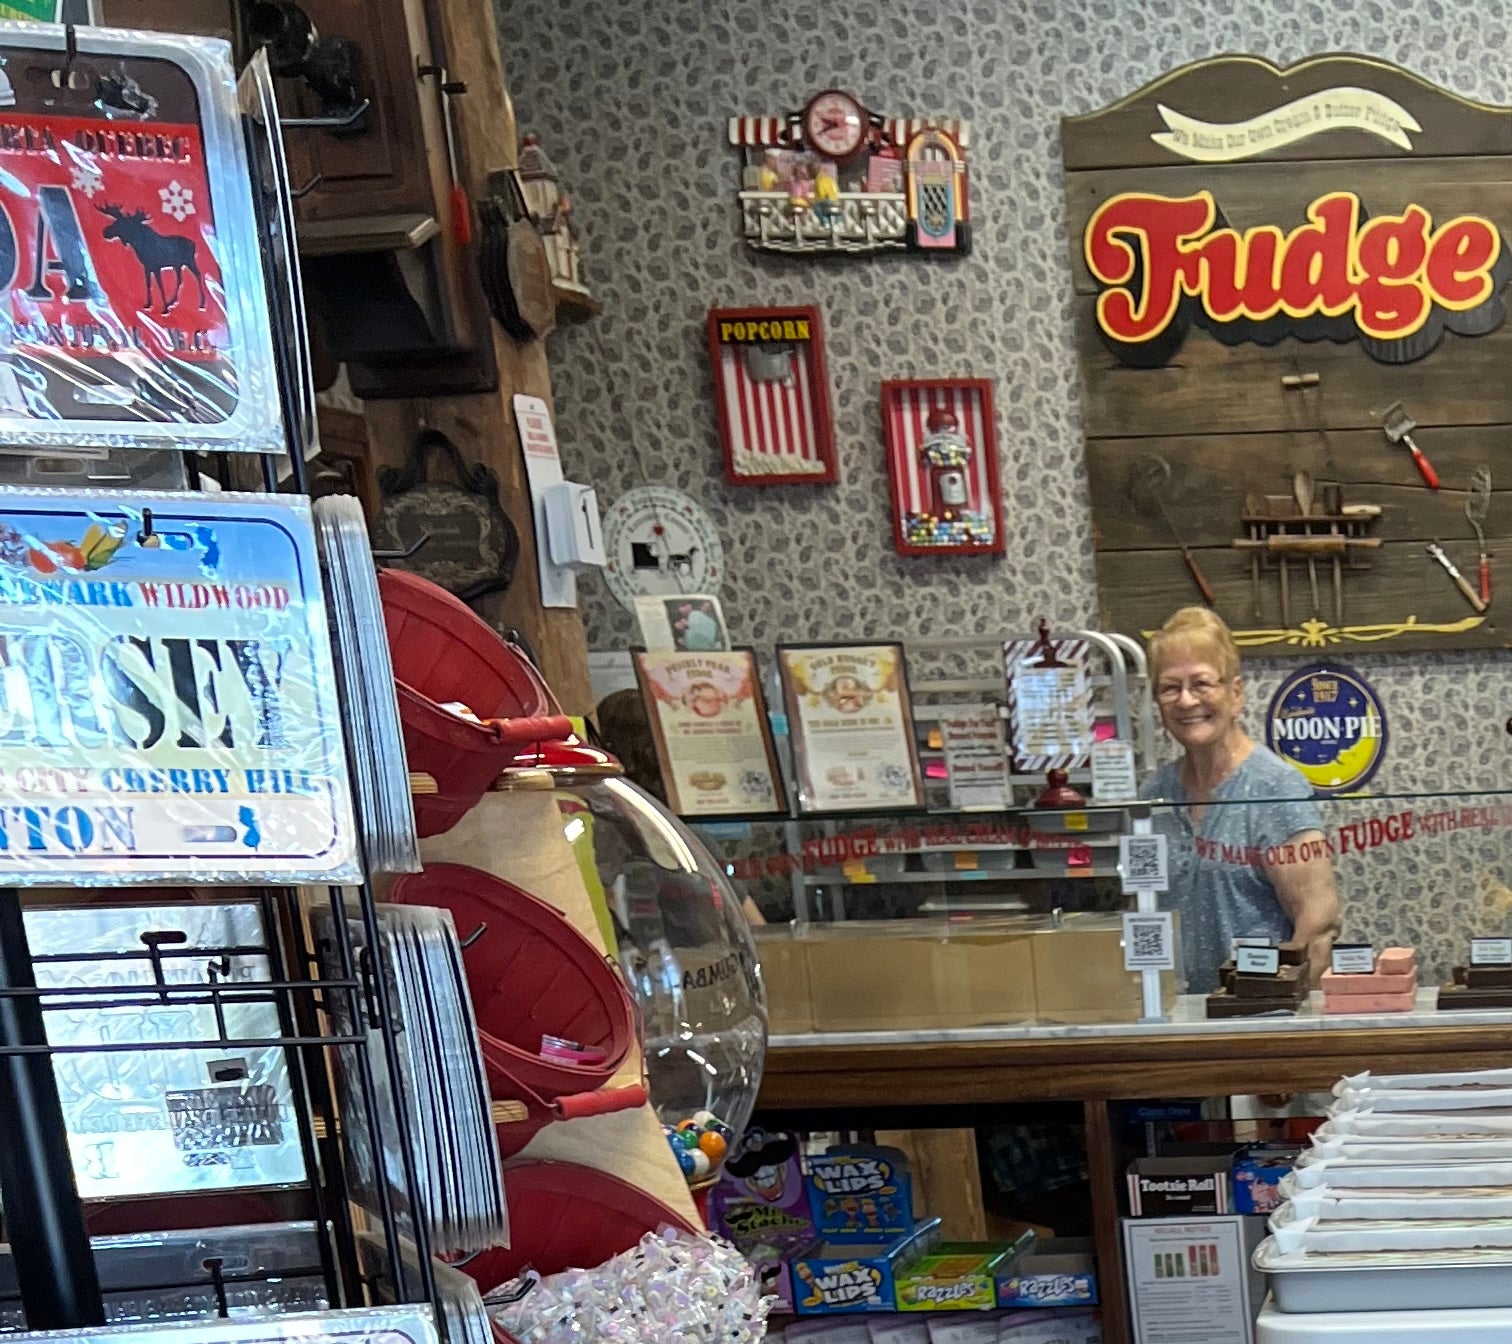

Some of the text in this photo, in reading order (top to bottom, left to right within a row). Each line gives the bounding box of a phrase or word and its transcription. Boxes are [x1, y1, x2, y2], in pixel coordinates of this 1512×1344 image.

[1086, 192, 1499, 343] Fudge
[720, 320, 810, 341] POPCORN
[139, 582, 291, 610] WILDWOOD
[0, 633, 294, 751] RSEY
[1272, 715, 1382, 740] MOON PIE
[102, 767, 230, 795] CHERRY
[1266, 843, 1297, 867] OUR
[1299, 837, 1335, 864] OWN
[1338, 811, 1415, 854] FUDGE
[1418, 812, 1458, 834] WITH
[815, 1160, 881, 1180] WAX
[825, 1174, 886, 1194] LIPS
[1140, 1177, 1216, 1193] Tootsie Roll
[815, 1267, 873, 1291] WAX
[823, 1282, 879, 1305] LIPS
